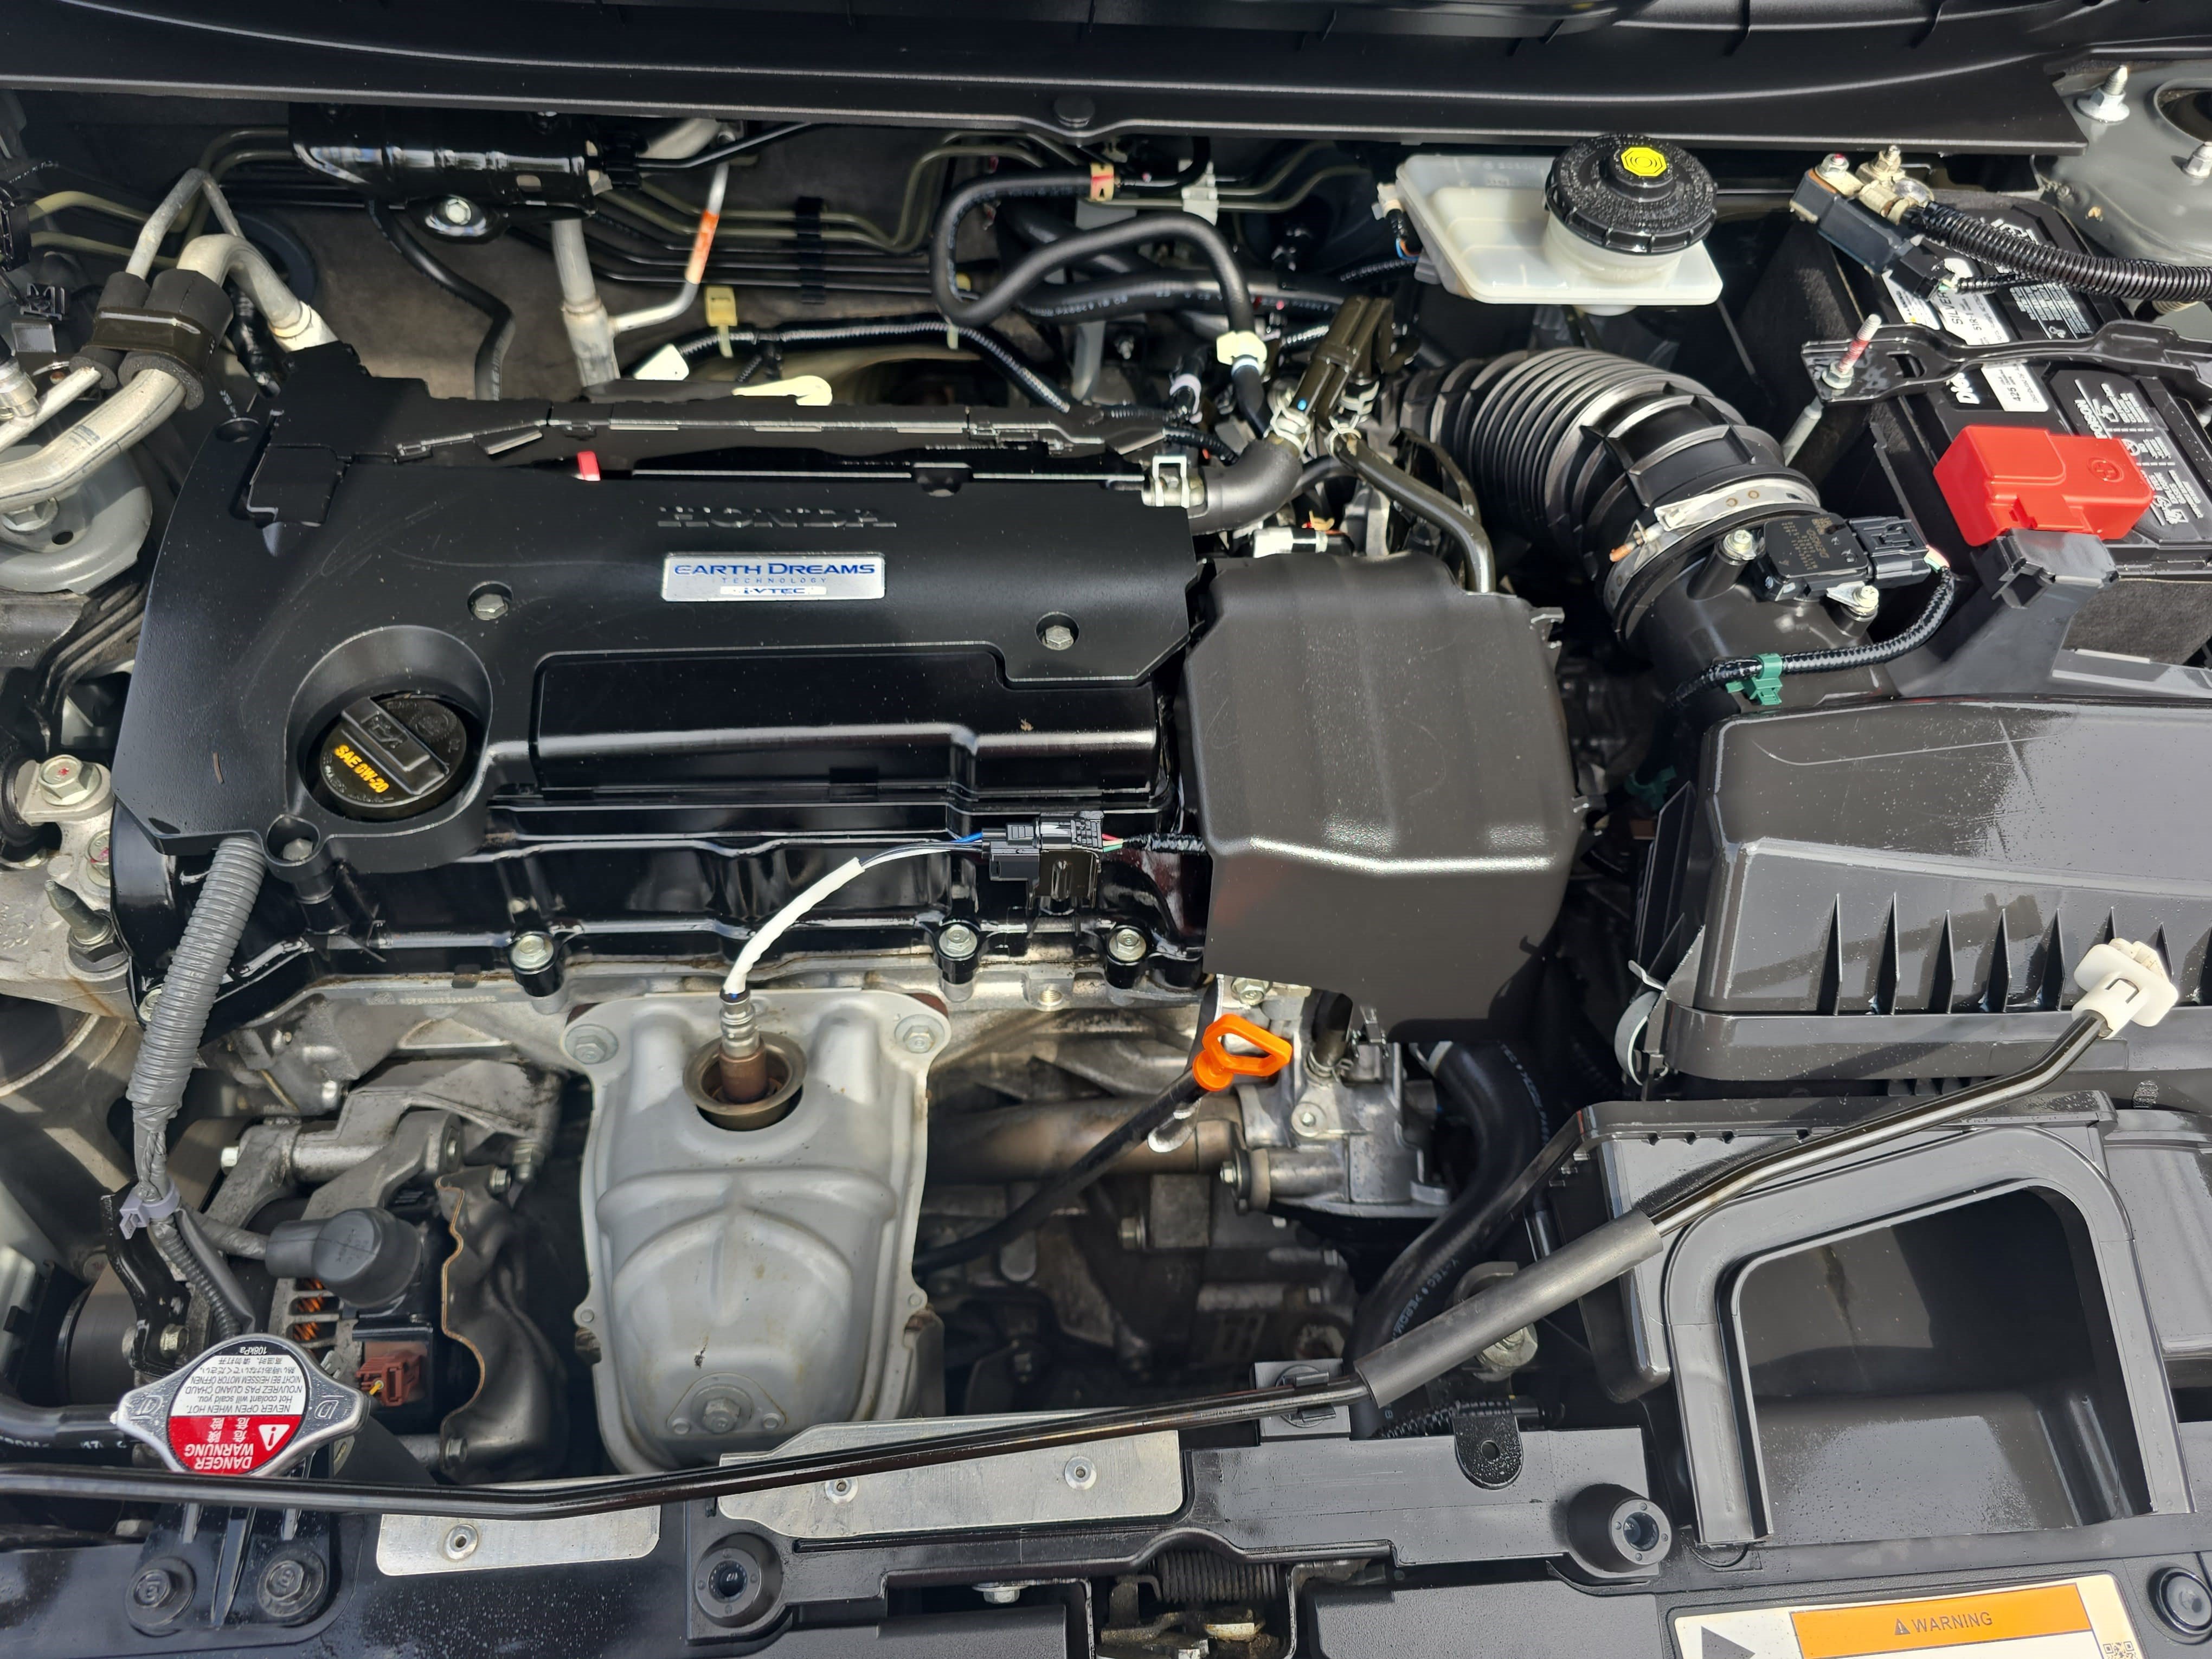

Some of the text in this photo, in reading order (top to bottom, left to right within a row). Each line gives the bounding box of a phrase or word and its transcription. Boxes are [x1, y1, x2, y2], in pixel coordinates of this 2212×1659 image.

[2007, 387, 2022, 402] 425
[657, 506, 897, 528] HONDA
[1806, 529, 1830, 558] DENSO
[674, 562, 876, 575] EARTH DREAMS
[334, 744, 362, 768] SAE
[354, 762, 389, 793] 0W-20
[240, 1346, 267, 1355] 108kPa
[217, 1376, 241, 1384] MOTOR
[282, 1375, 301, 1384] NICHT
[262, 1385, 303, 1393] N'OUVREZ
[249, 1396, 277, 1404] coolant
[279, 1396, 293, 1404] Hot
[186, 1405, 205, 1413] HOT.
[235, 1405, 259, 1413] OPEN
[184, 1443, 254, 1457] WARNUNG
[194, 1456, 253, 1470] DANGER
[1911, 1612, 1993, 1634] WARNING
